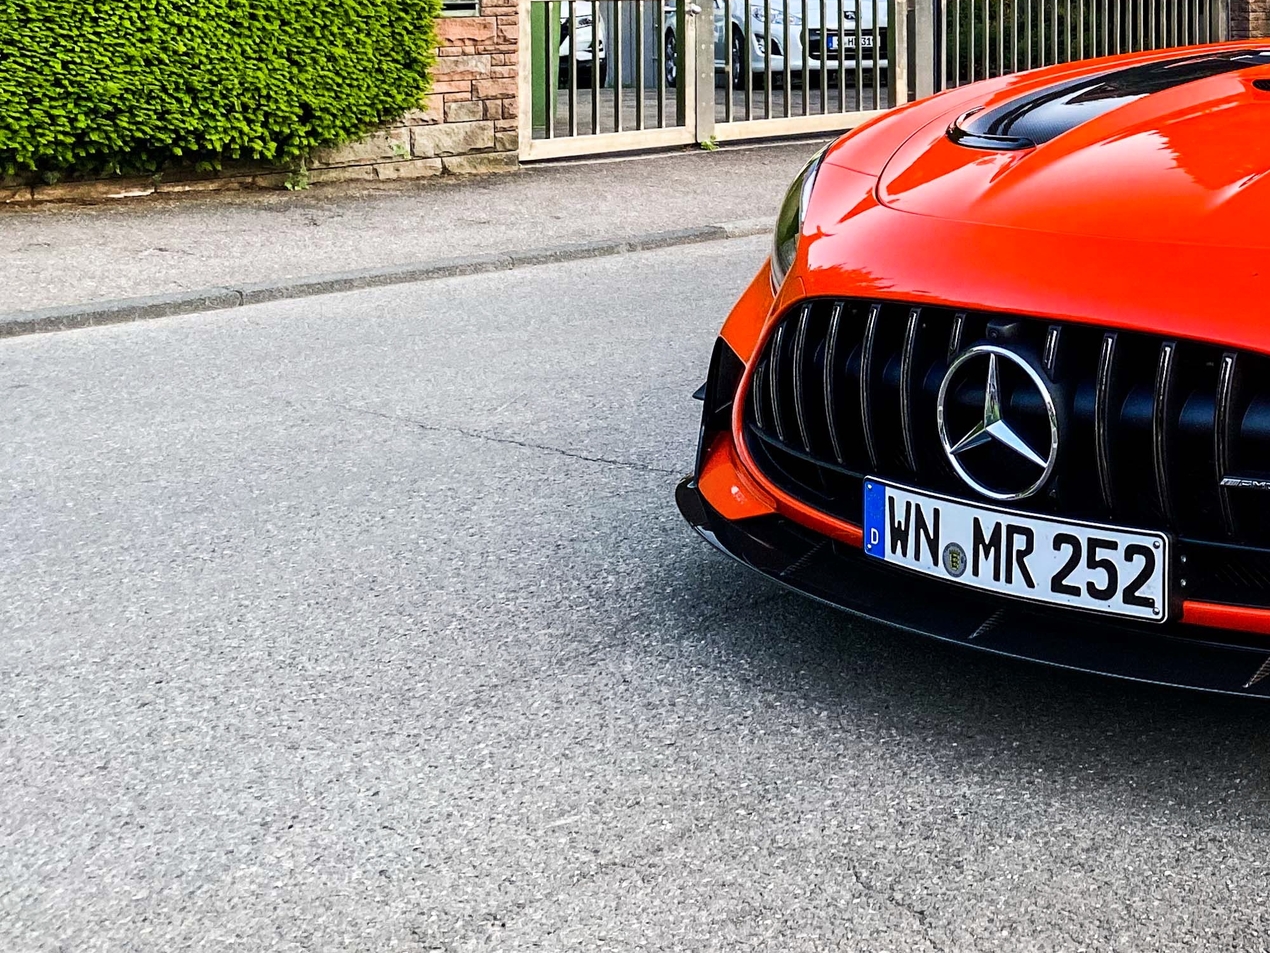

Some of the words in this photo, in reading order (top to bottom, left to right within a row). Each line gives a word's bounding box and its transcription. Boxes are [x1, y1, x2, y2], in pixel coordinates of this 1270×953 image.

[870, 528, 879, 545] D
[888, 495, 940, 567] WN
[972, 516, 1036, 589] MR
[1050, 532, 1156, 609] 252
